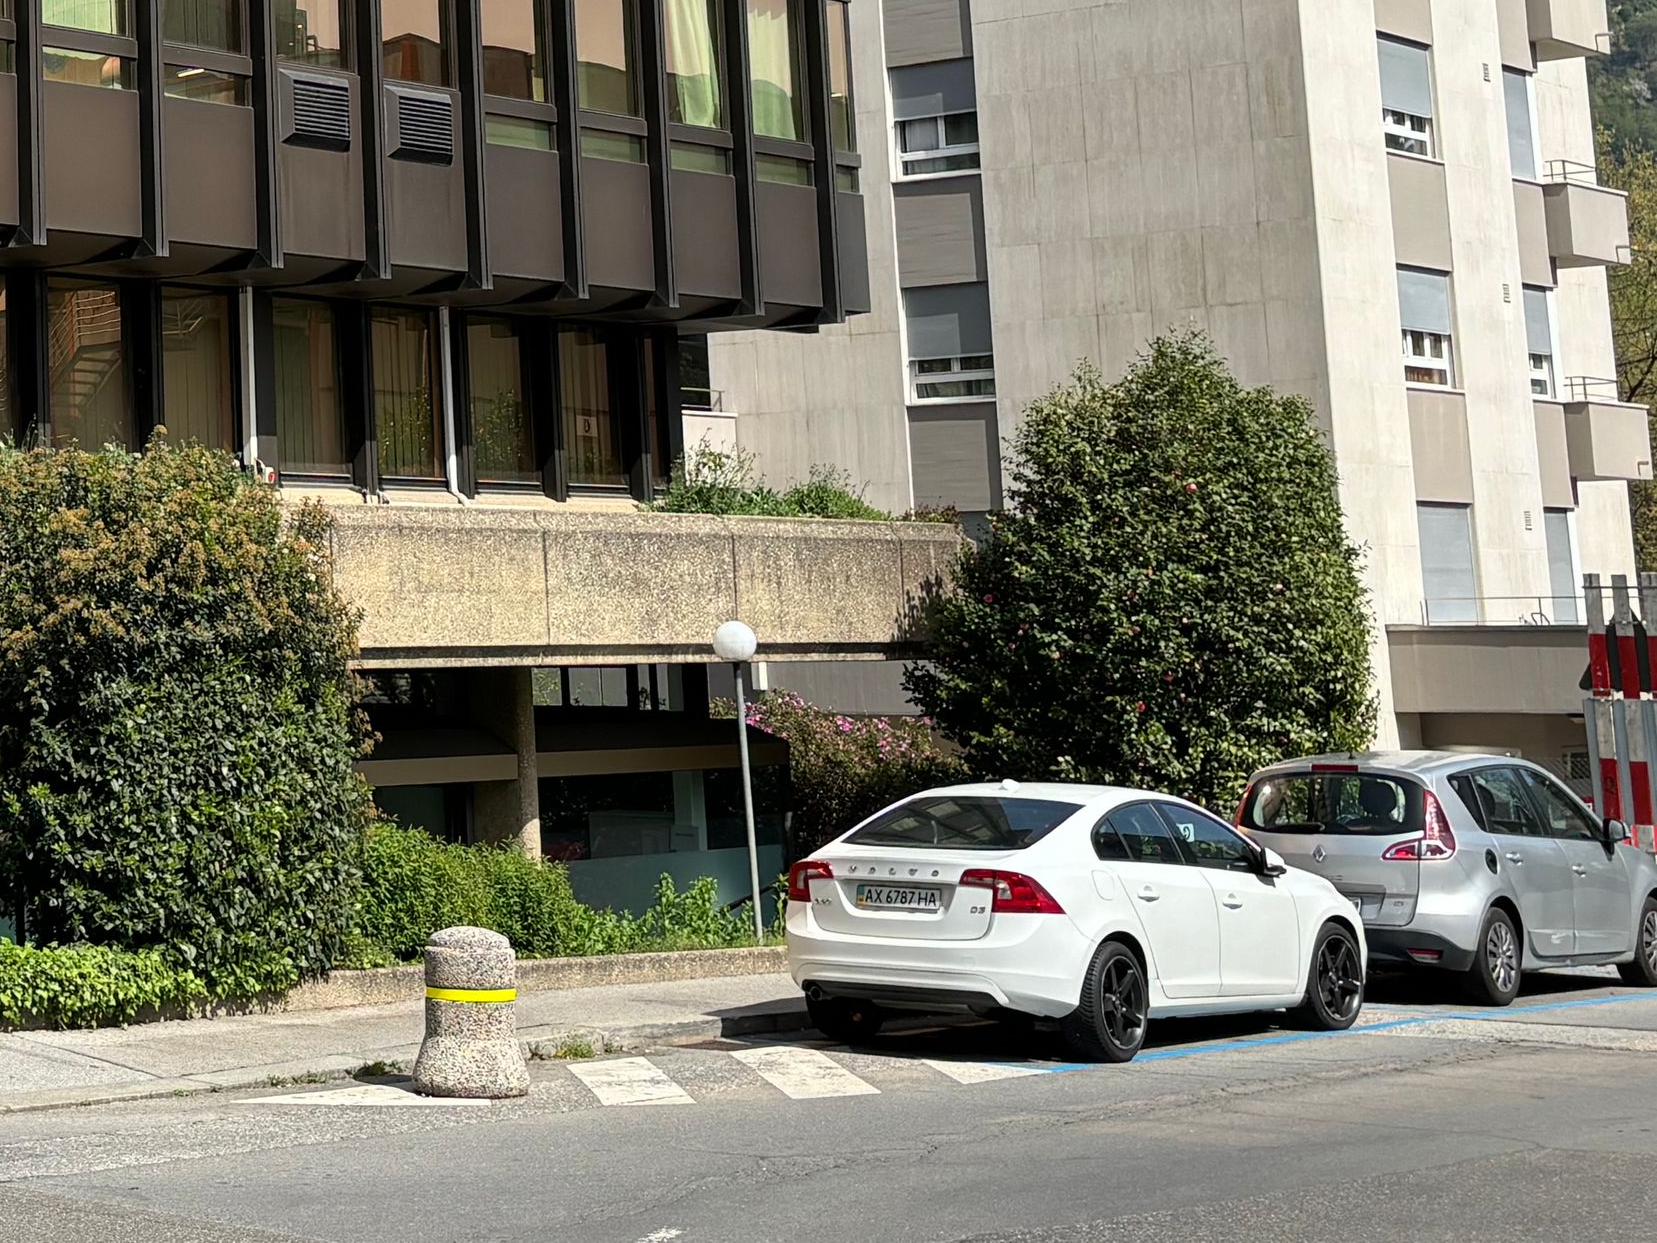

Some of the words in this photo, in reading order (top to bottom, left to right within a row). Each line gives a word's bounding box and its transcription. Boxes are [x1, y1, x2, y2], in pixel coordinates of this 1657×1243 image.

[864, 888, 884, 904] AX
[885, 889, 916, 905] 6787
[917, 891, 937, 907] HA
